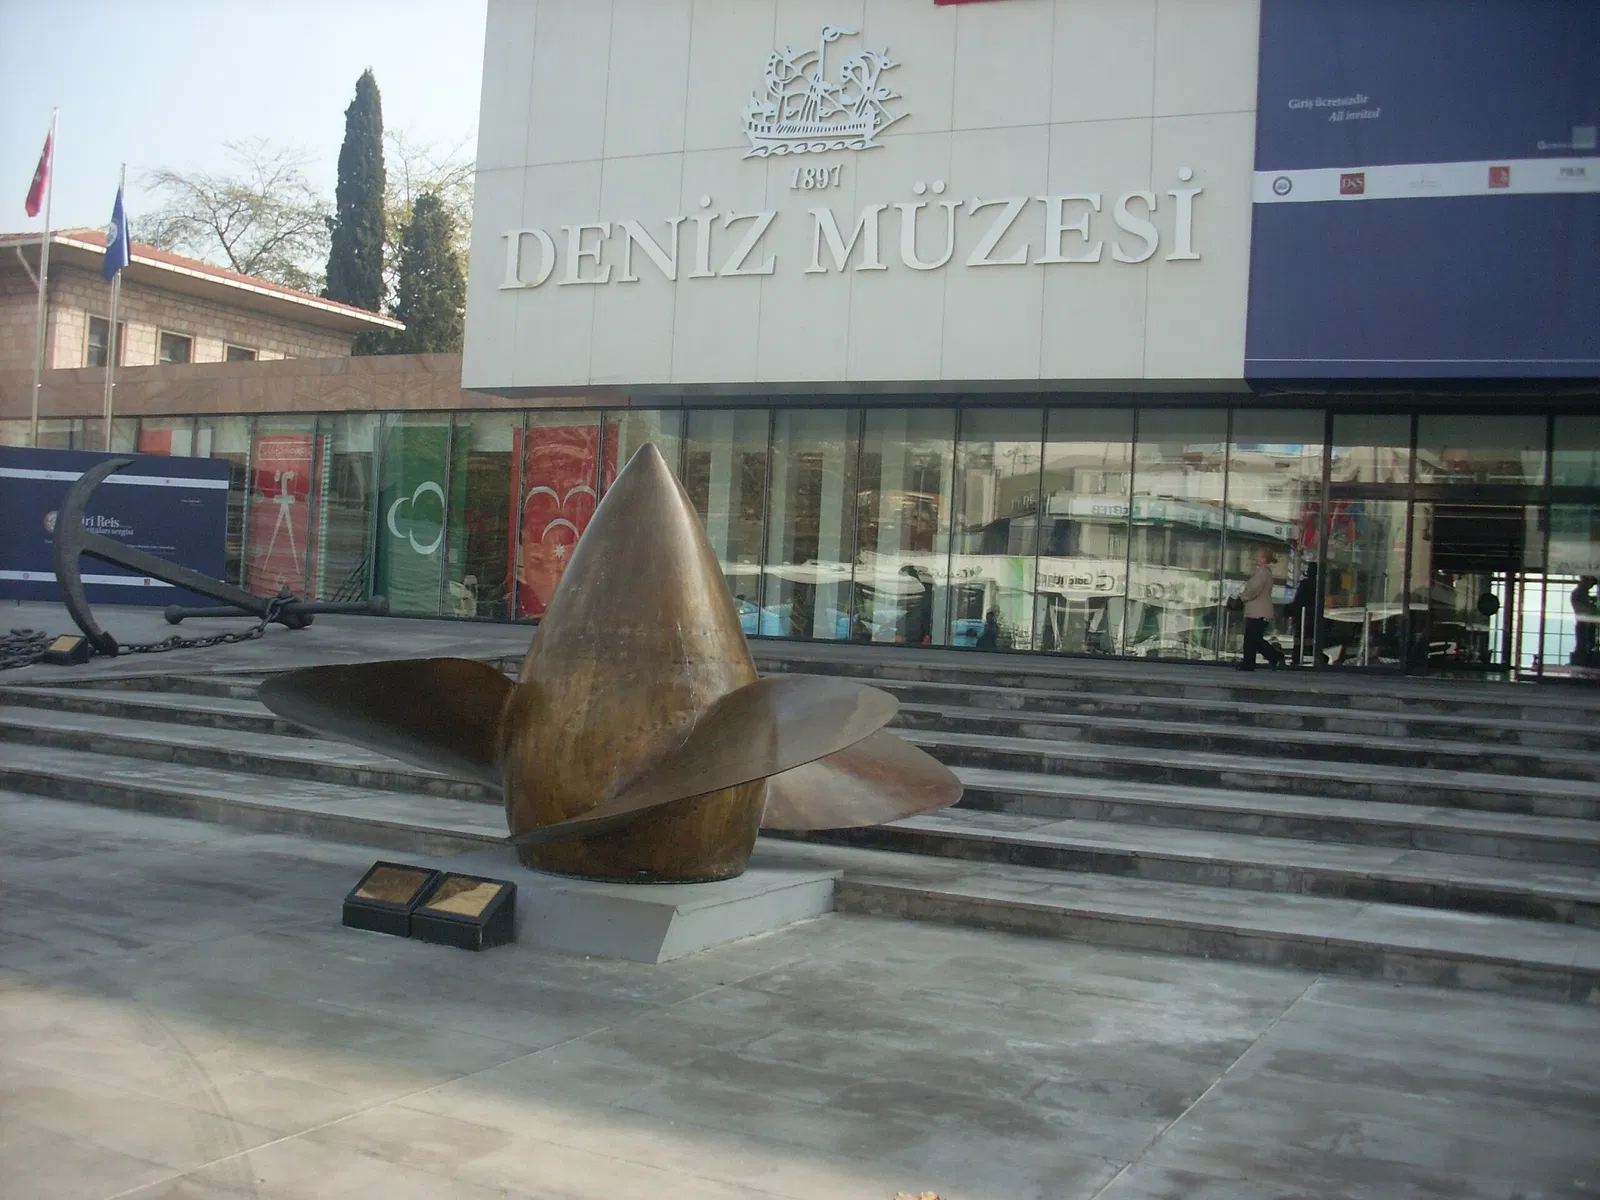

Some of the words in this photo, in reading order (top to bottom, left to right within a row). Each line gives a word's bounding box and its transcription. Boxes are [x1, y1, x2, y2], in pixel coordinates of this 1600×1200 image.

[1288, 98, 1313, 112] Giriş
[790, 164, 843, 190] 1897
[497, 195, 778, 290] DENİZ
[804, 166, 1203, 273] MÜZESİ
[97, 514, 120, 528] Reis
